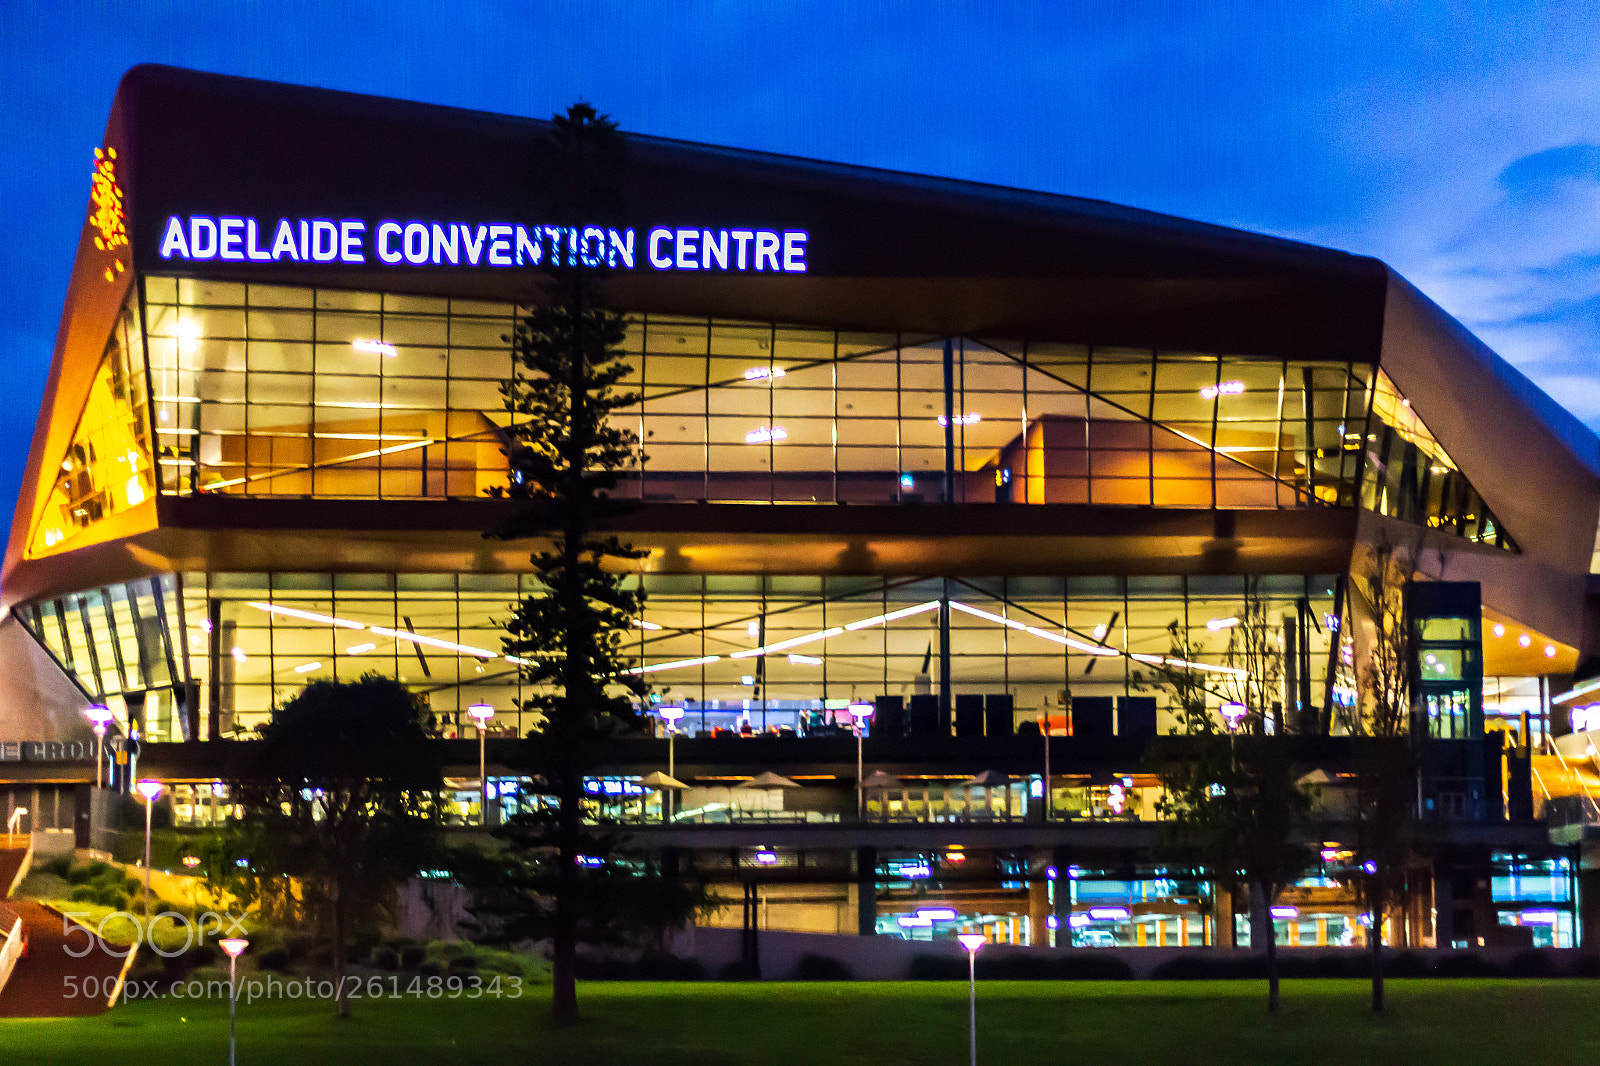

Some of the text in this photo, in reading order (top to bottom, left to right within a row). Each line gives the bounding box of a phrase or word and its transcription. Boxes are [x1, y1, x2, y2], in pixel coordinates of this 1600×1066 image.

[160, 215, 808, 273] ADELAIDE CONVENTION CENTRE
